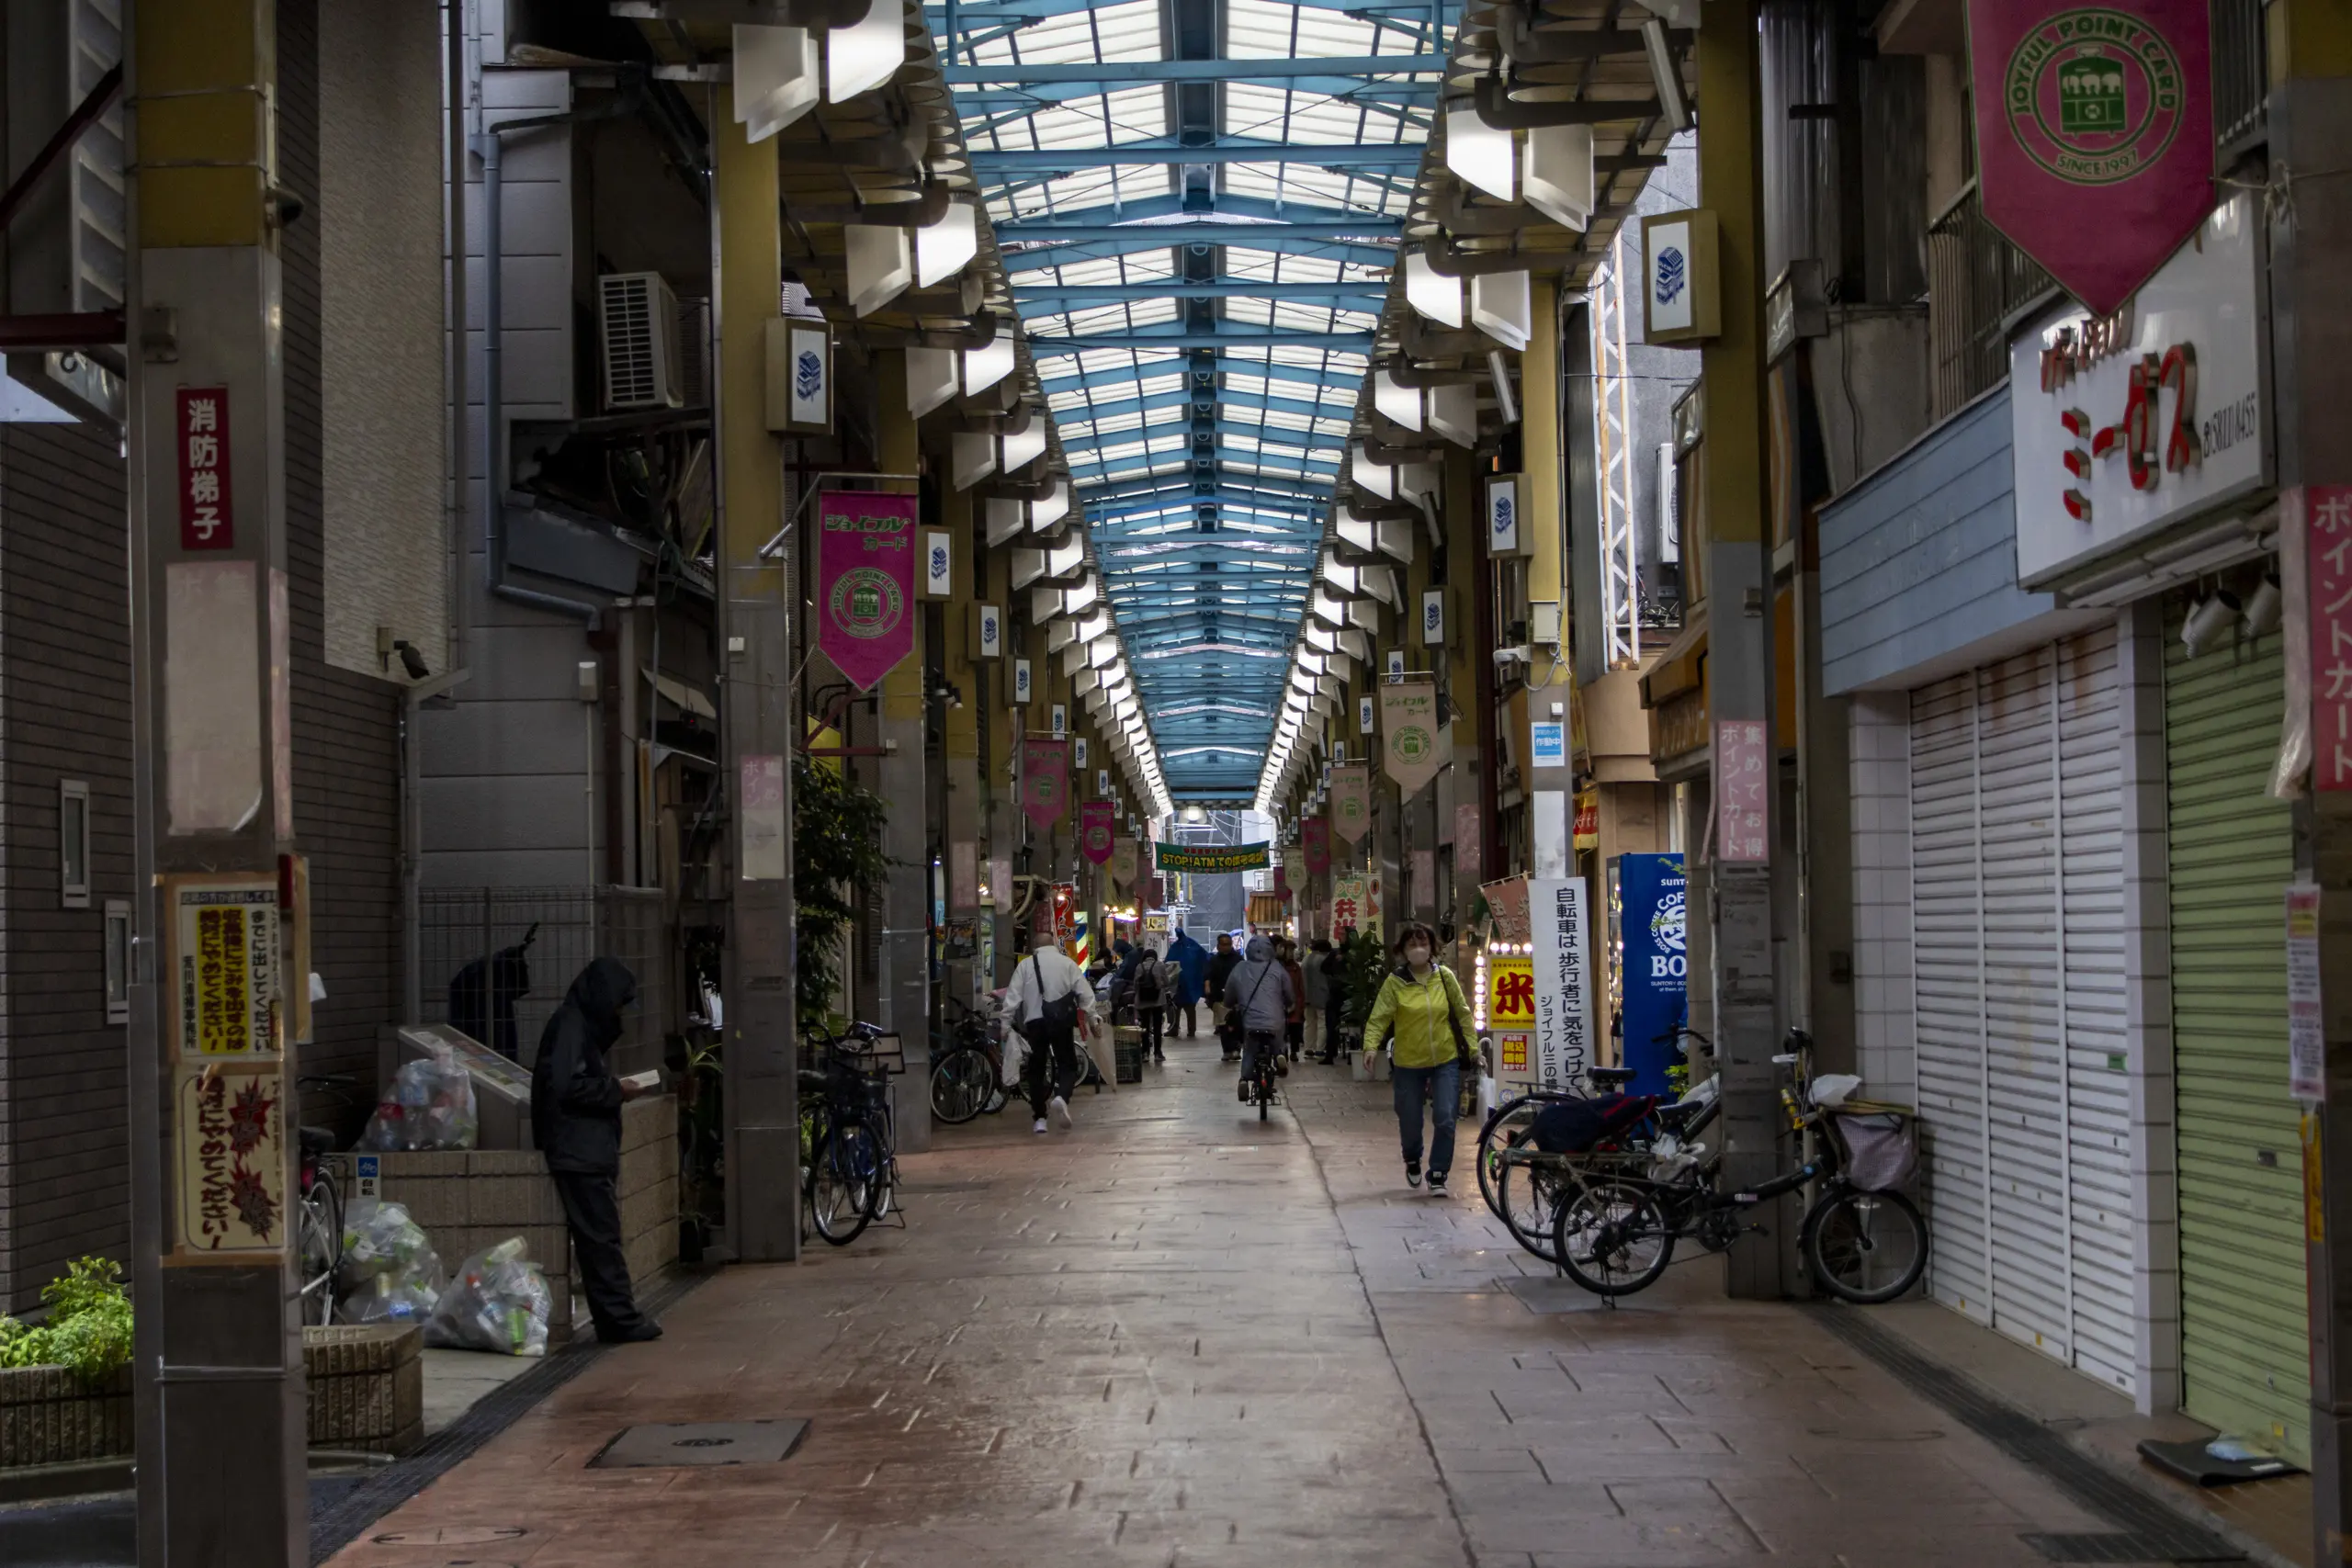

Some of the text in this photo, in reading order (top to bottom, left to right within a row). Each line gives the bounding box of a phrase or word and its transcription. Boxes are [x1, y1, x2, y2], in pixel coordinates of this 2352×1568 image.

[2009, 16, 2176, 114] JOYFUL POINT CARD
[2057, 149, 2139, 175] SINCE 1997
[187, 400, 221, 541] 消防梯子
[825, 514, 910, 533] ジョイフル
[864, 536, 908, 551] カード
[1721, 725, 1741, 855] ポイントカード
[1744, 726, 1764, 857] 集めてお得
[1660, 878, 1685, 886] SUNT
[1657, 892, 1685, 910] COF
[1650, 955, 1687, 977] BO
[1496, 972, 1535, 1015] 米
